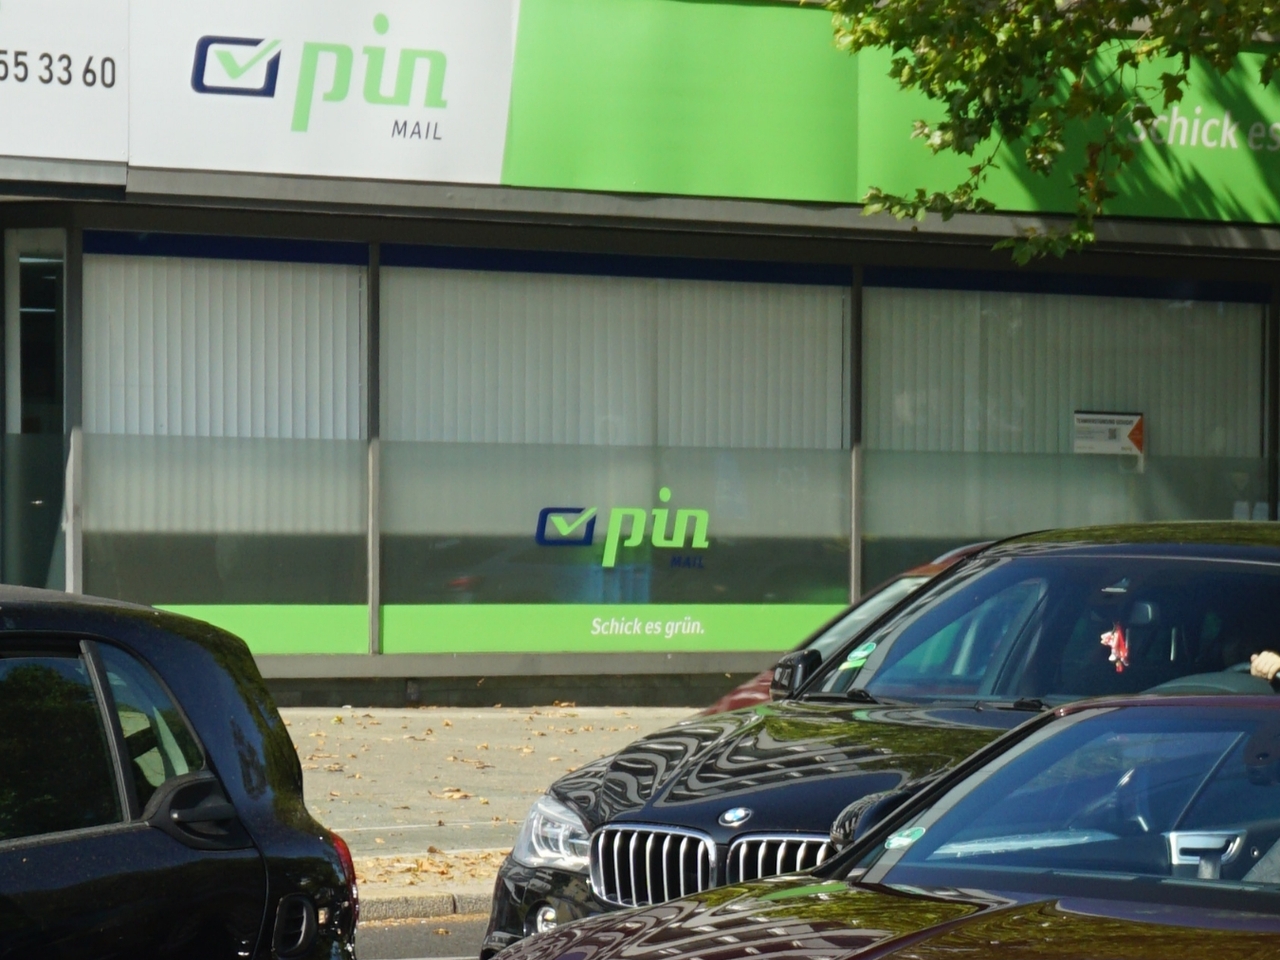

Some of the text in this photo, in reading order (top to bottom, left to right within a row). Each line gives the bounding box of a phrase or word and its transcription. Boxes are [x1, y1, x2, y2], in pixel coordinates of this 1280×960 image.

[38, 52, 73, 86] 33
[81, 55, 117, 89] 60
[290, 13, 448, 132] pin
[390, 119, 443, 141] MAIL
[601, 486, 710, 568] pin
[590, 616, 705, 639] Schick es grün.
